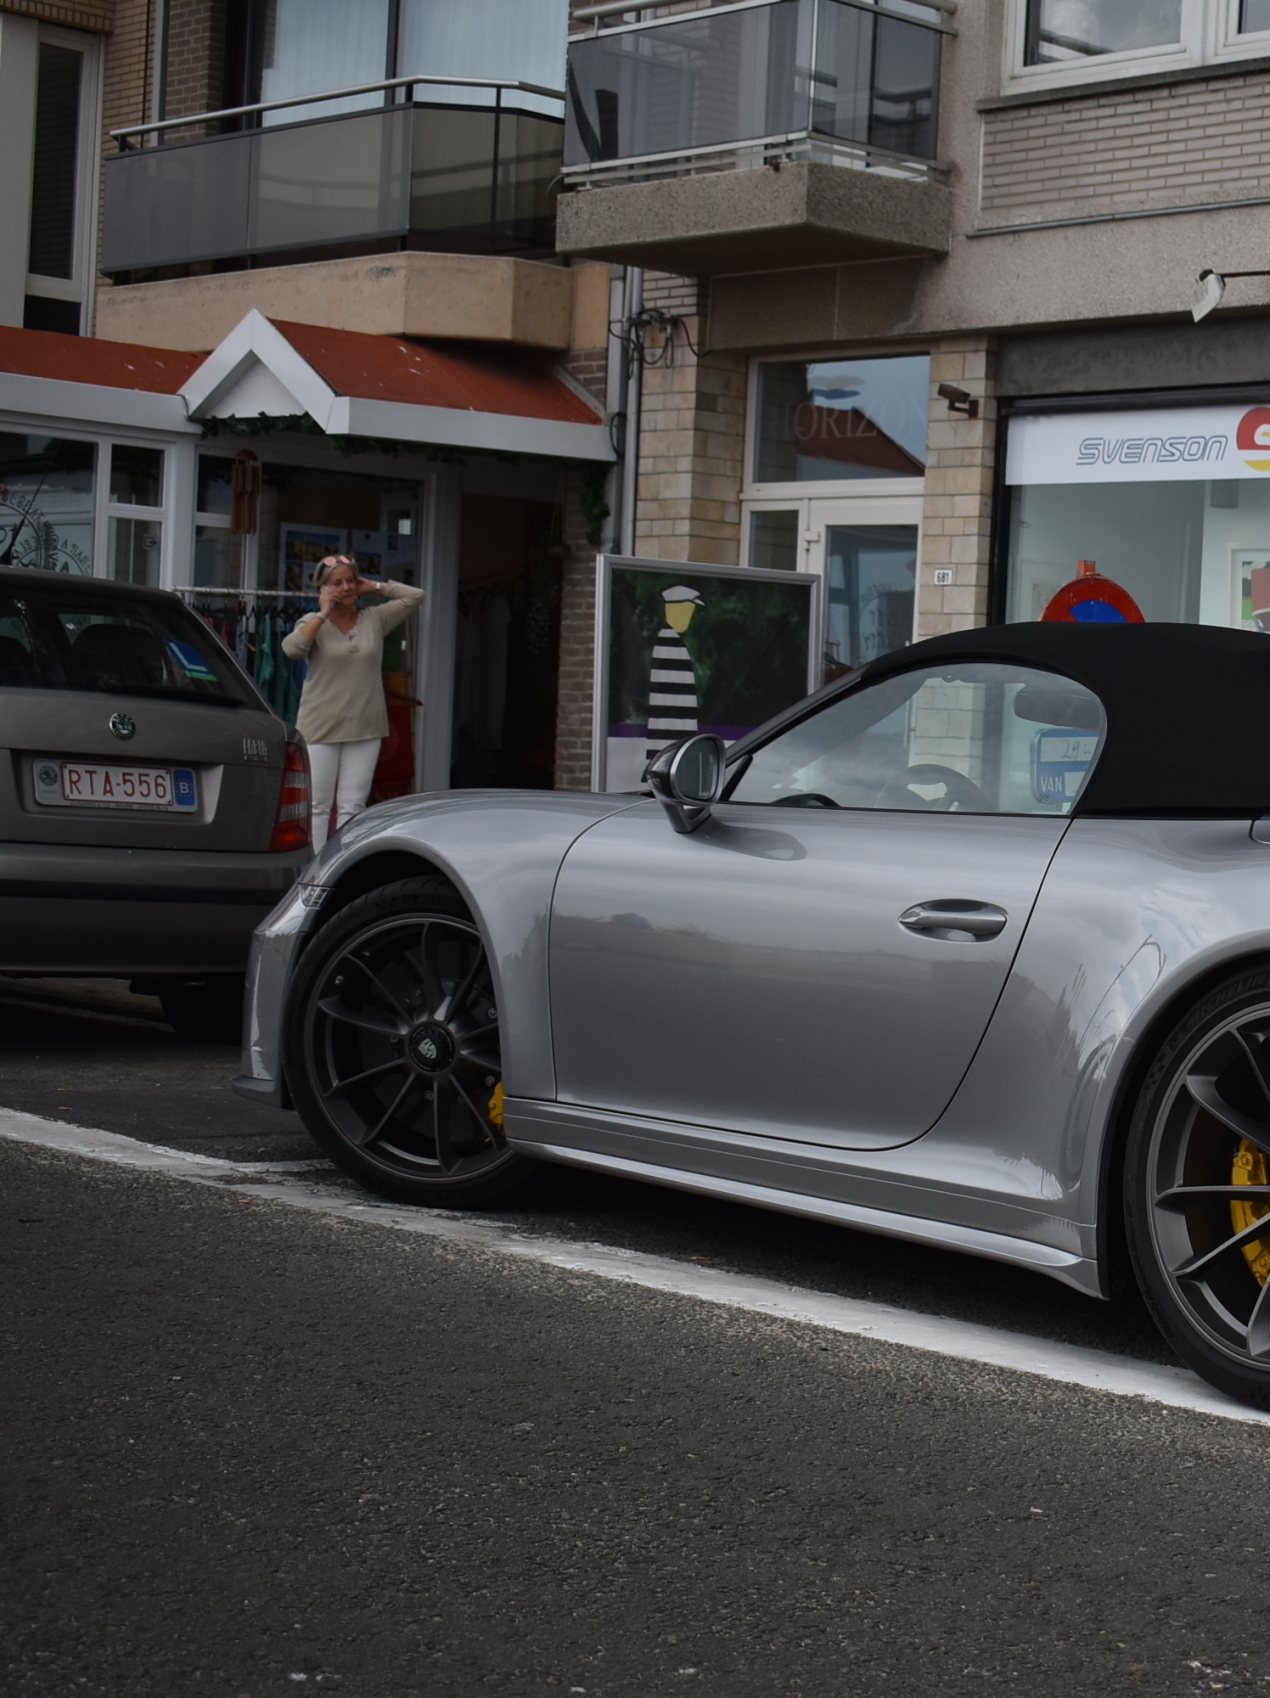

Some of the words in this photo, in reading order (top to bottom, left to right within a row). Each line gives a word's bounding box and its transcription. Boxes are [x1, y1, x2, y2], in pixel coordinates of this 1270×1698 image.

[1076, 435, 1228, 466] SVENSON
[937, 571, 950, 583] 681
[169, 642, 207, 671] L
[68, 769, 167, 799] RTA-556
[180, 782, 189, 794] B
[1041, 776, 1062, 792] VAN
[1186, 971, 1269, 1030] MICHELIN
